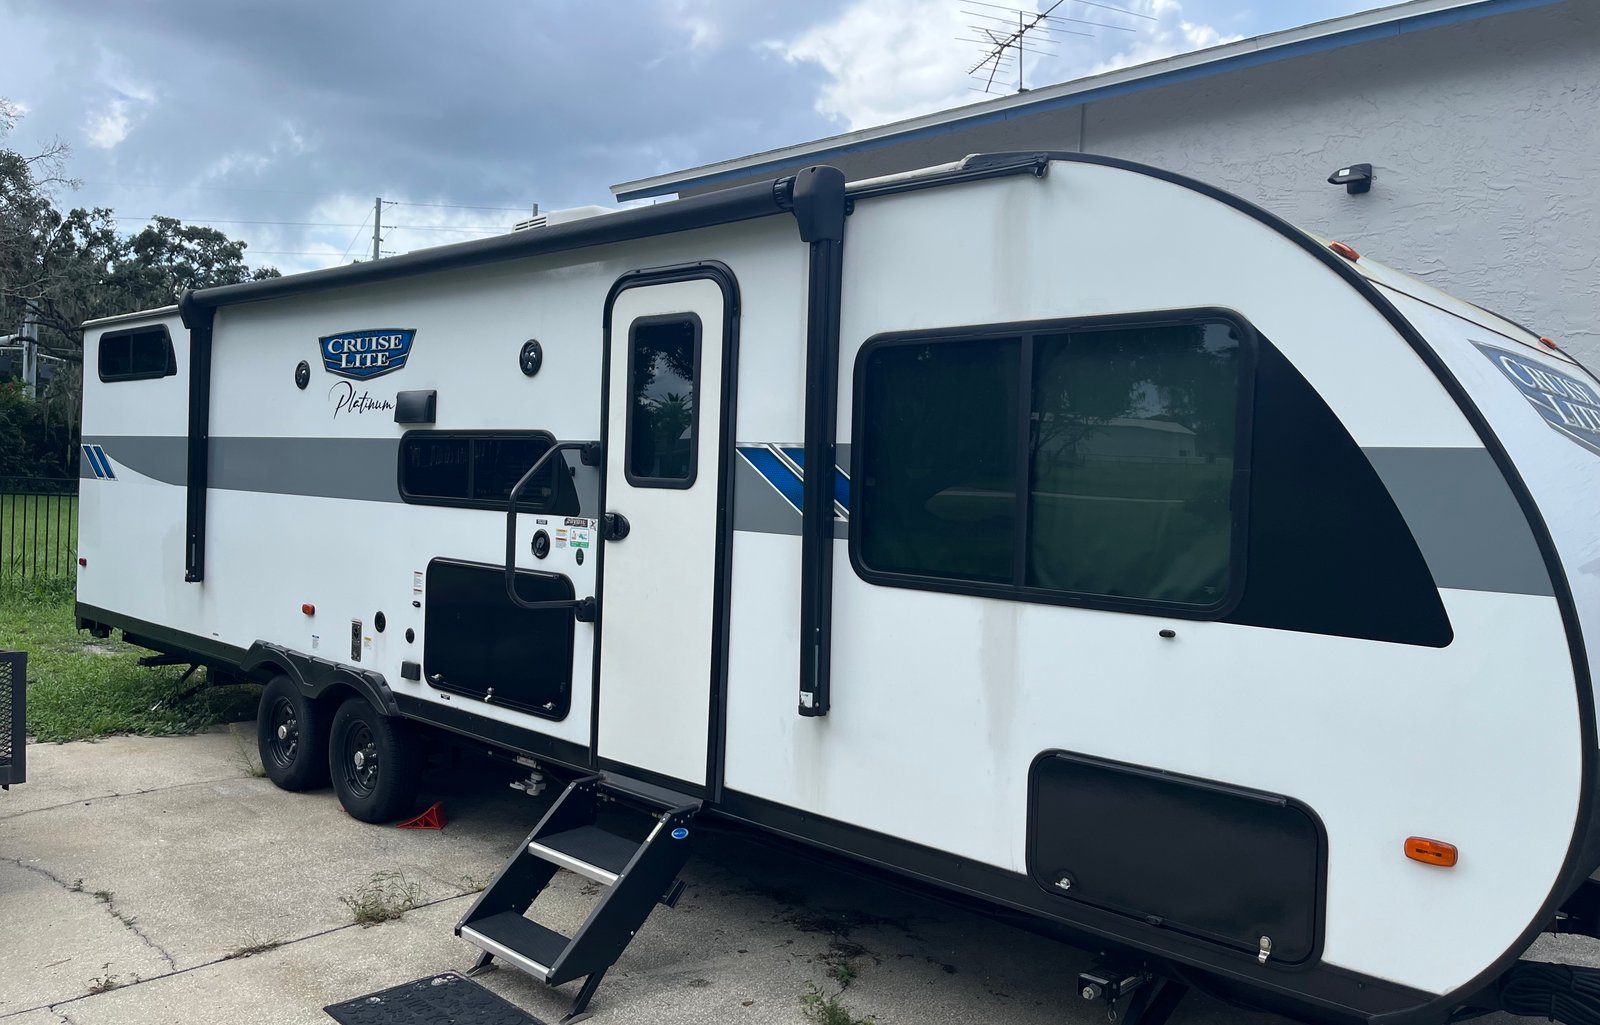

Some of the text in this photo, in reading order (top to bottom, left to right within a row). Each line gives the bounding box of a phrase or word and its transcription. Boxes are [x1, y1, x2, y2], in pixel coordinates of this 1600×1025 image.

[328, 335, 402, 354] CRUISE
[340, 352, 389, 369] LITE
[328, 380, 395, 420] Platinum
